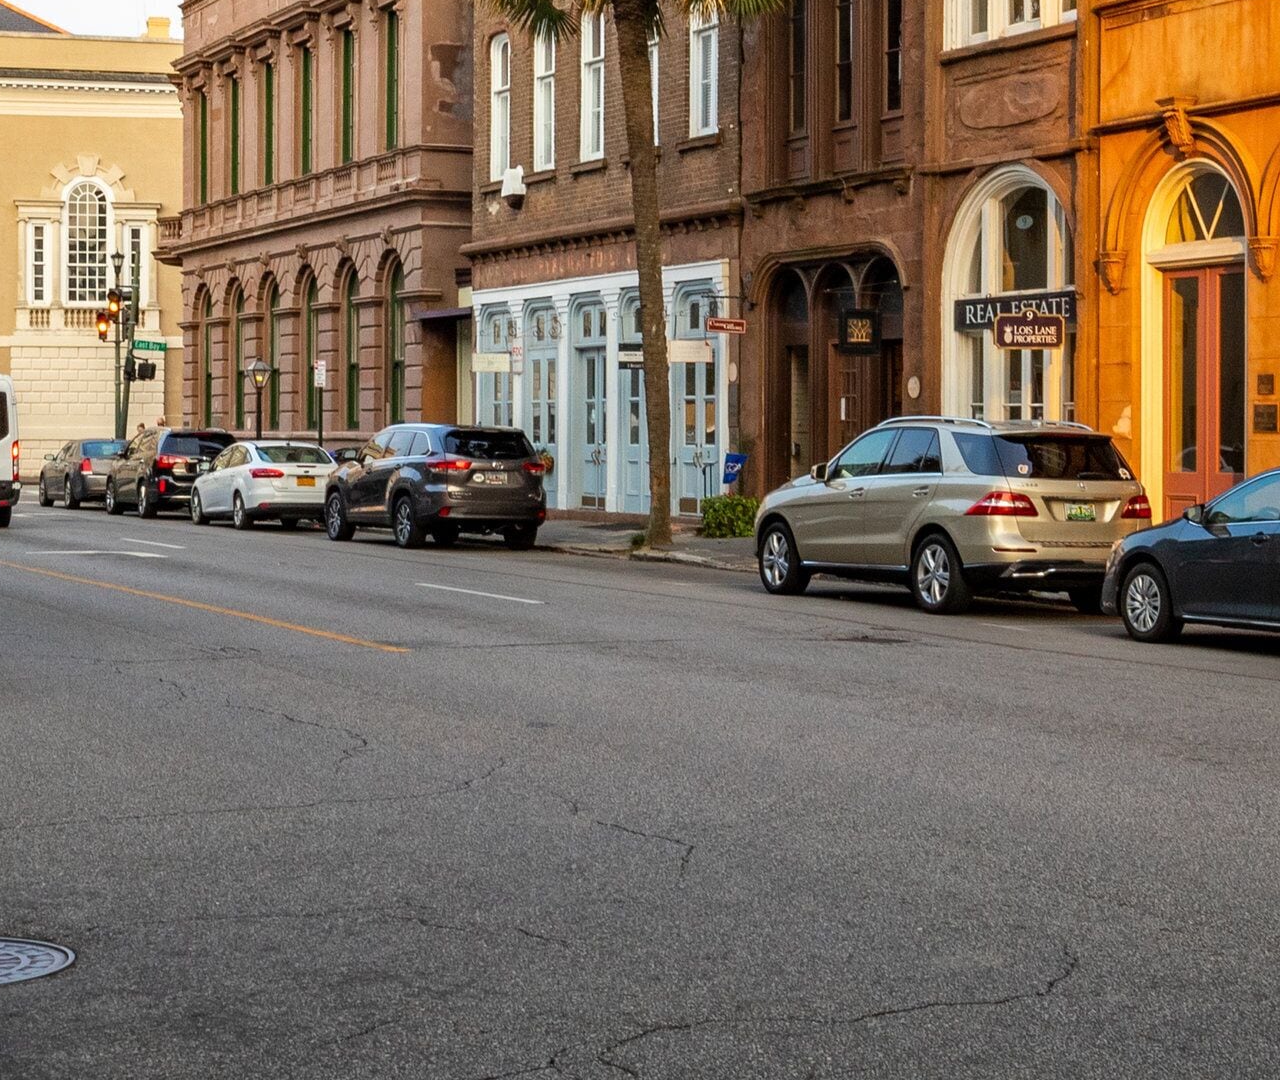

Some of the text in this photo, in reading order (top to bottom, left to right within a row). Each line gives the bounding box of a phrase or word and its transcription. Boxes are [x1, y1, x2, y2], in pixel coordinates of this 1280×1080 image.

[1011, 296, 1070, 317] ESTATE
[1026, 311, 1034, 321] 9
[1013, 325, 1057, 335] LOIS LANE
[1013, 335, 1057, 343] PROPERTIES
